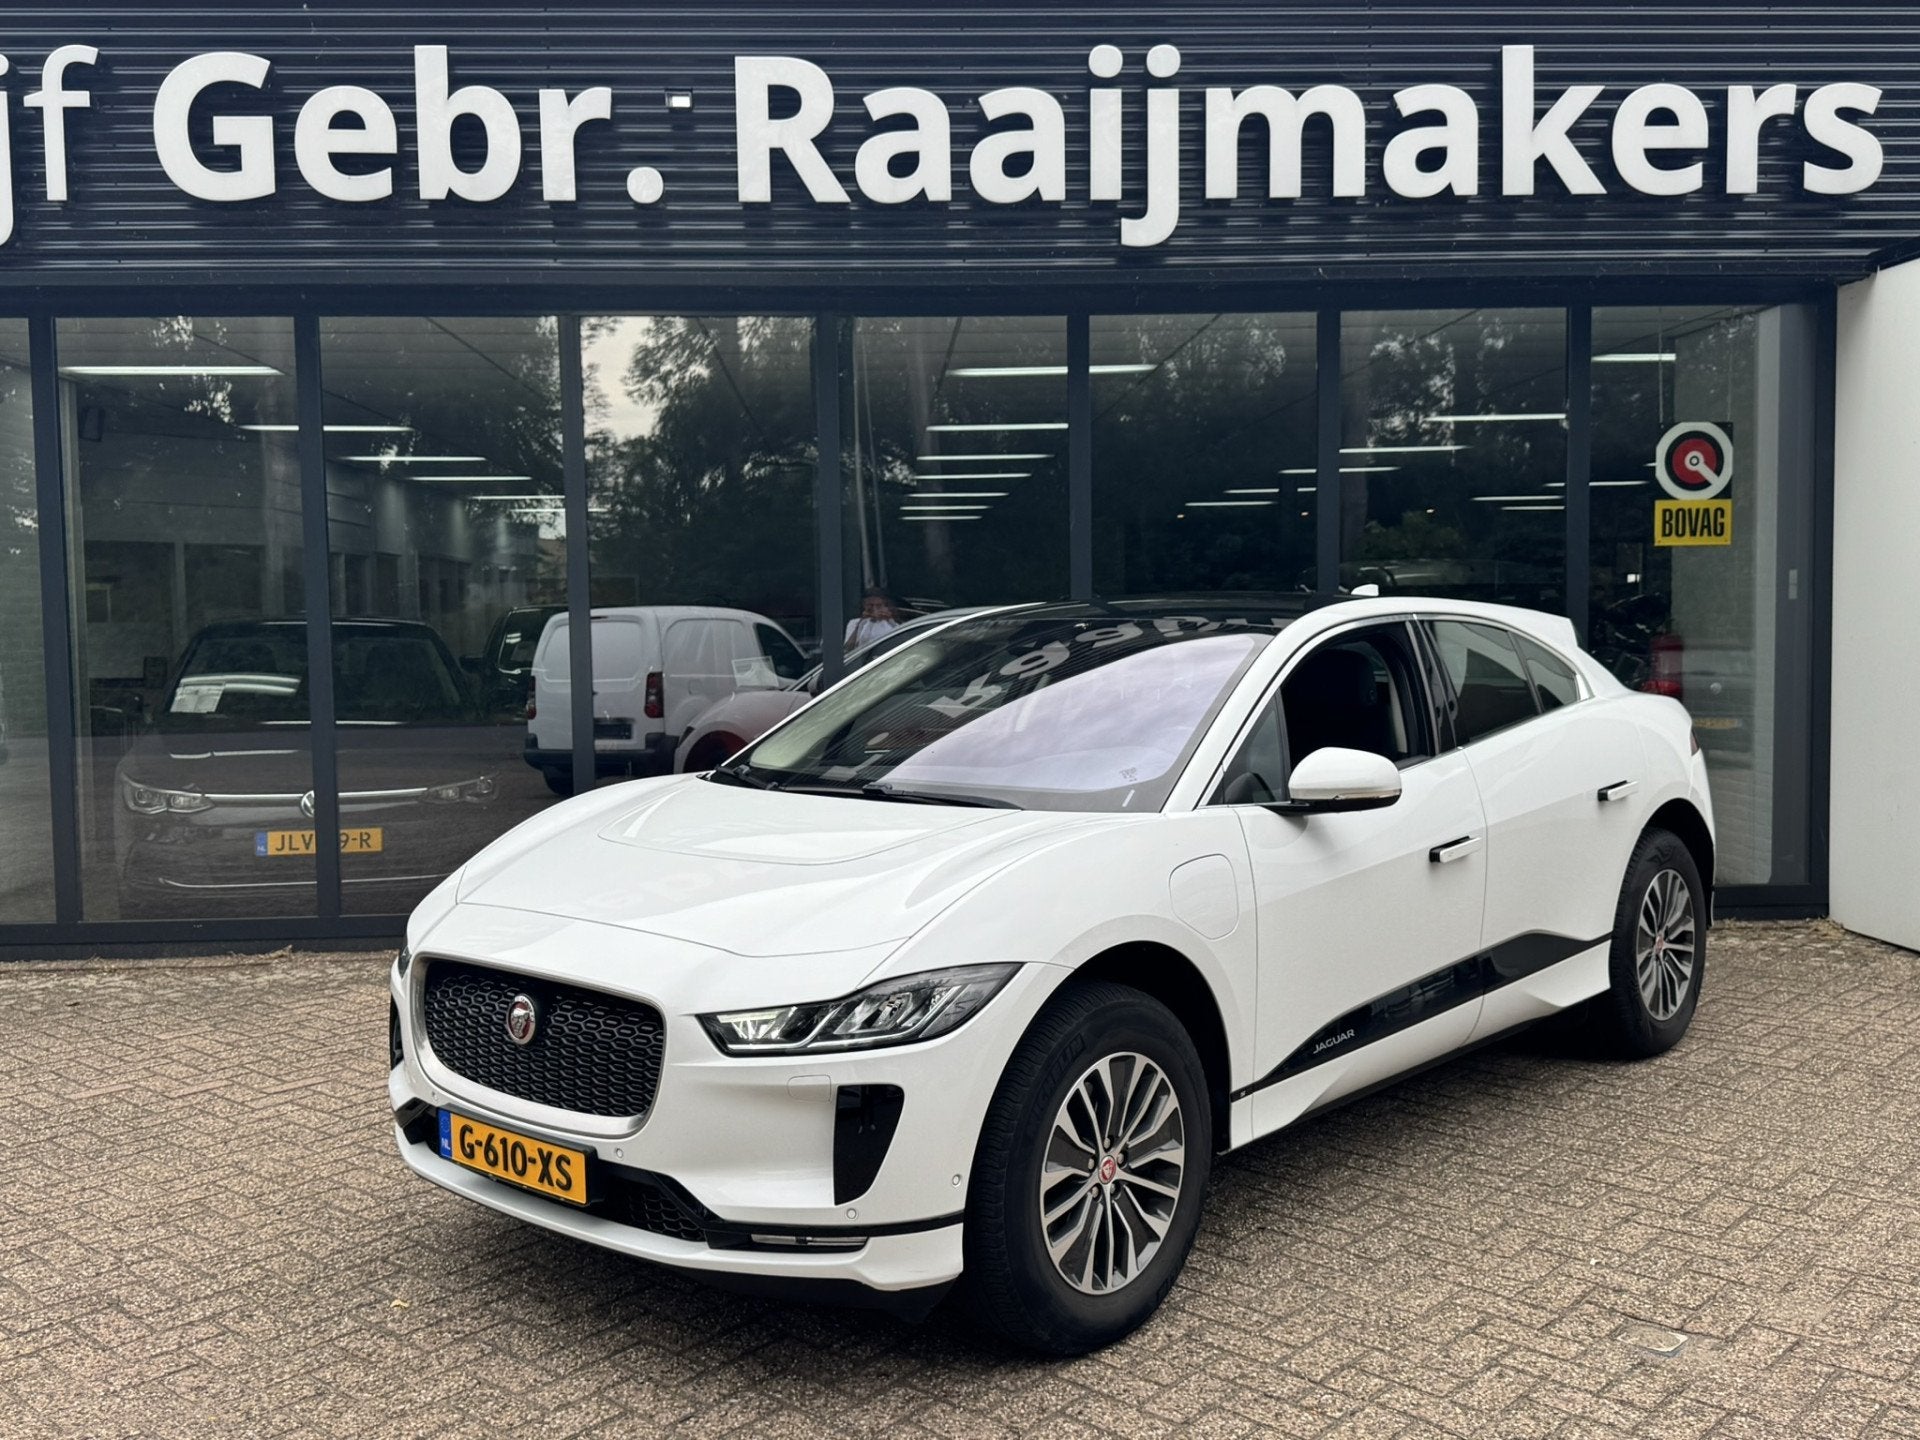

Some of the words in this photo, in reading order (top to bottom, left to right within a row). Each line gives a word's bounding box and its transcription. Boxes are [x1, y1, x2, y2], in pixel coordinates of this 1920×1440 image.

[153, 44, 664, 203] Gebr.
[734, 44, 1884, 247] Raaijmakers
[1661, 507, 1725, 537] BOVAG
[1313, 1028, 1356, 1054] JAGUAR
[441, 1137, 451, 1150] NL
[459, 1123, 573, 1192] G-610-XS
